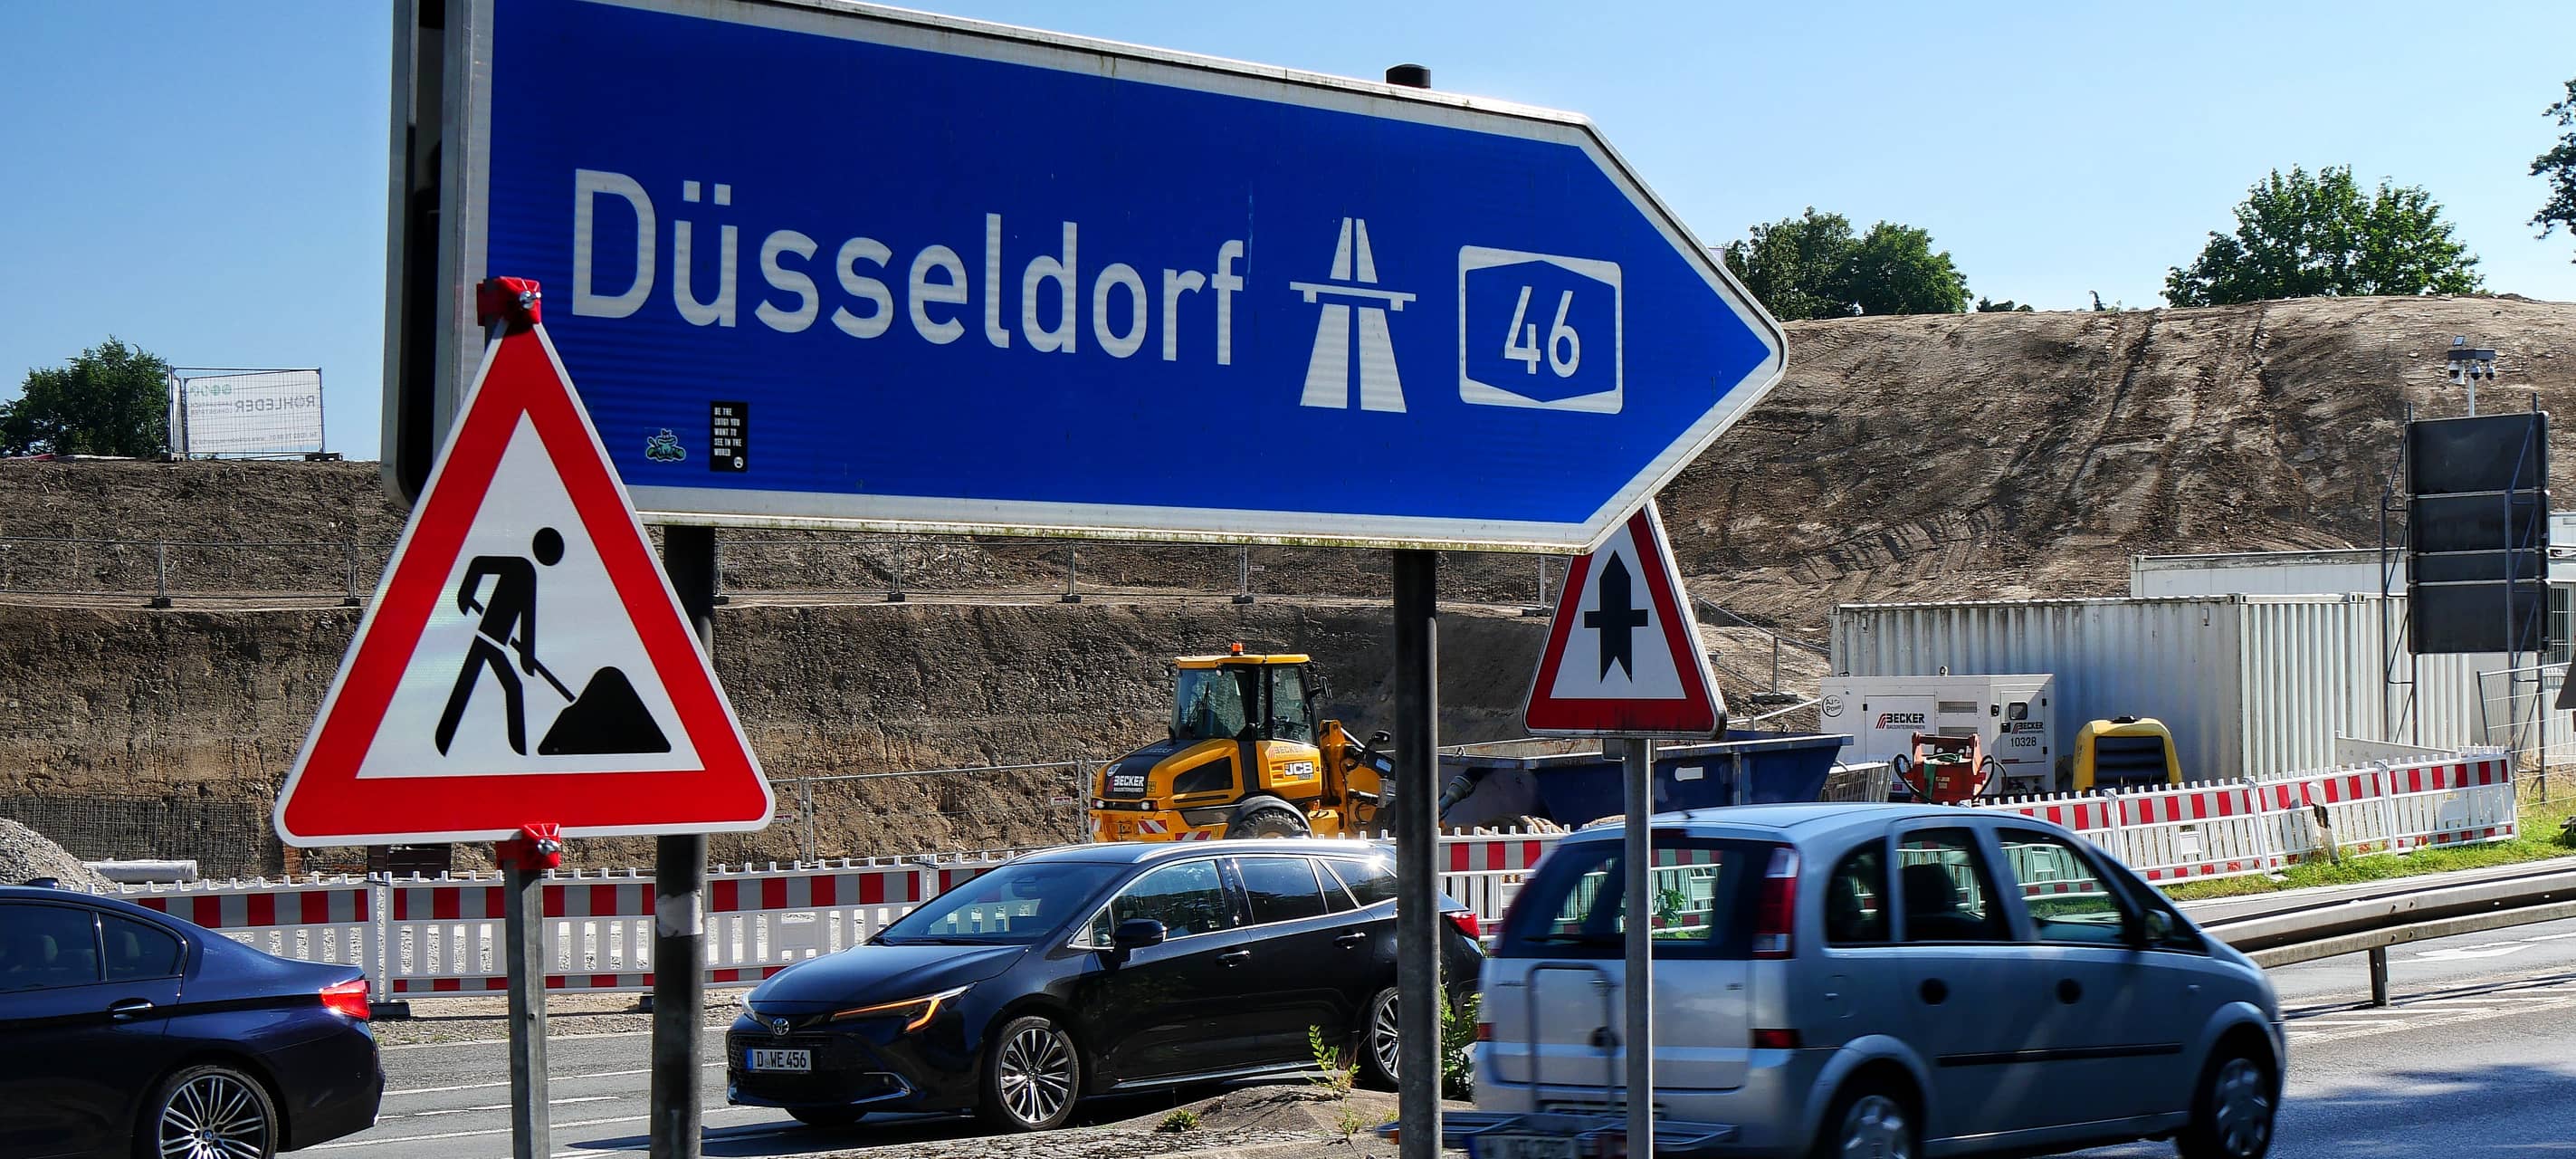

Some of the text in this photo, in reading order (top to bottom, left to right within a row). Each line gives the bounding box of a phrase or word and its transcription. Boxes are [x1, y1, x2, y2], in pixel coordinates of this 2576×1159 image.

[571, 168, 1244, 365] Düsseldorf
[1504, 285, 1580, 378] 46
[1885, 713, 1925, 723] BECKER
[2018, 721, 2044, 730] BECKER
[2010, 736, 2037, 747] 10328
[1284, 761, 1314, 776] JCB
[1113, 775, 1145, 787] BECKER
[786, 1051, 806, 1068] 456
